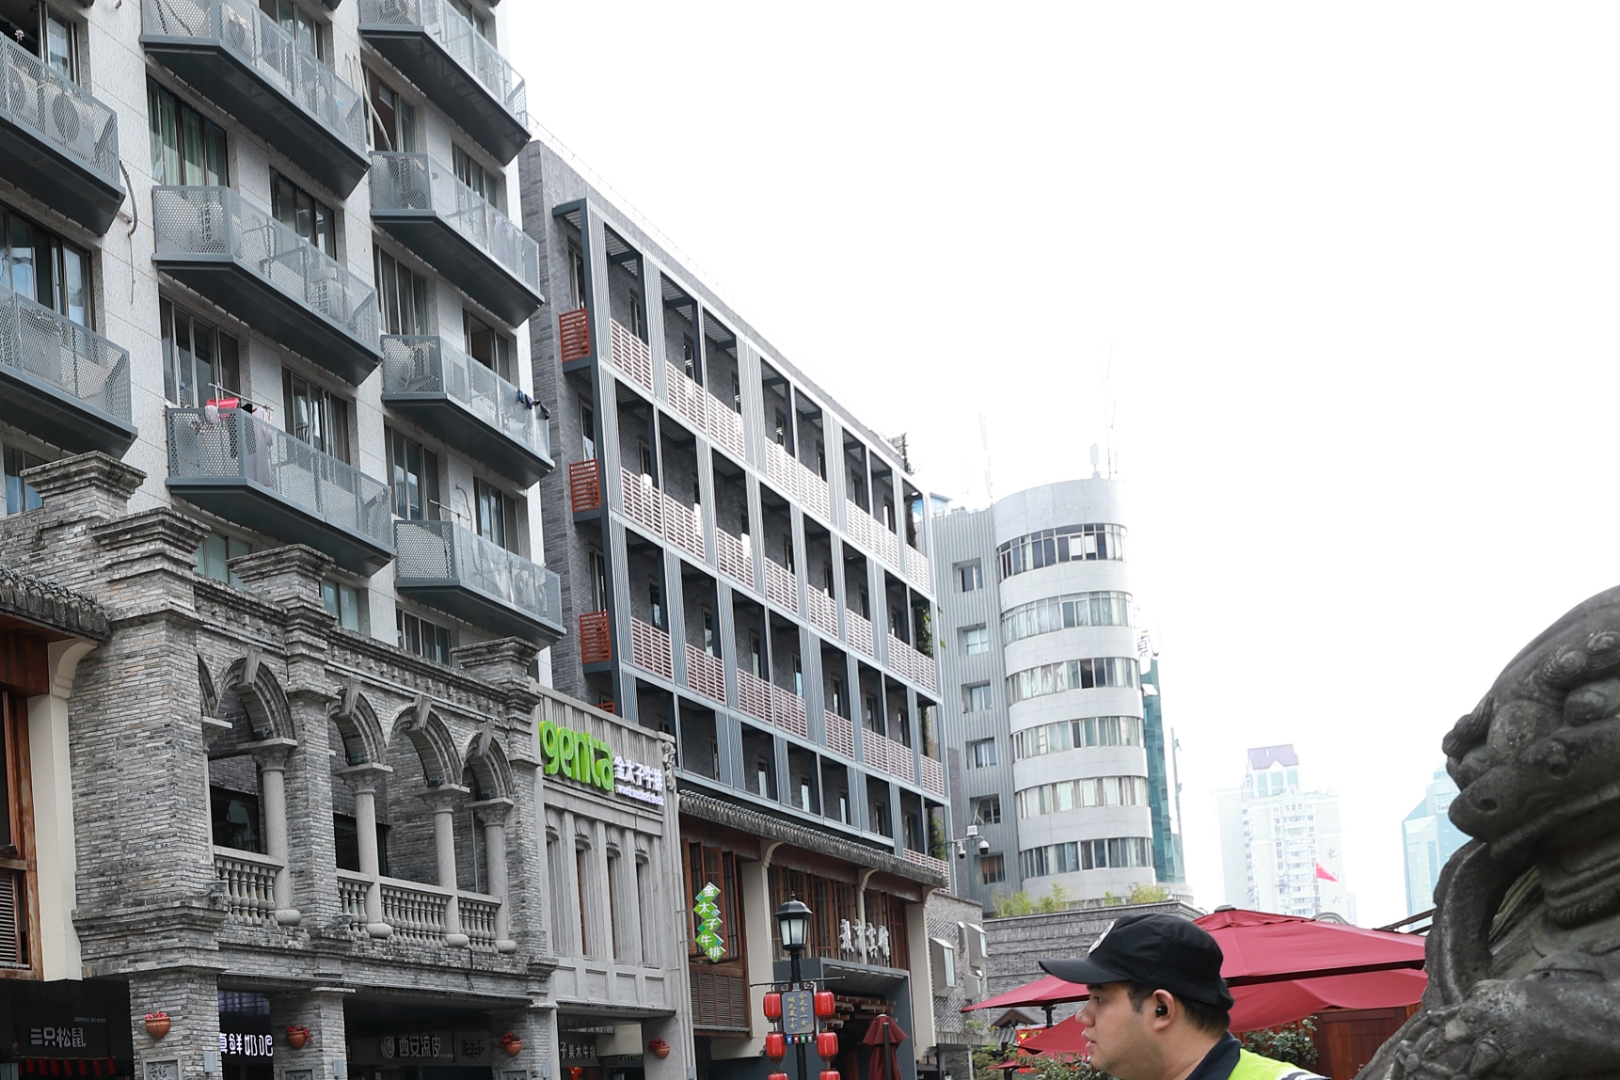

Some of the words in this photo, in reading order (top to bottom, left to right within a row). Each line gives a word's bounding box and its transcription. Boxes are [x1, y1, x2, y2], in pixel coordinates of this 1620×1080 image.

[538, 720, 614, 792] genta
[613, 756, 664, 792] 金太子牛排
[698, 884, 722, 958] 金太子牛排
[30, 1026, 86, 1048] 三只松鼠
